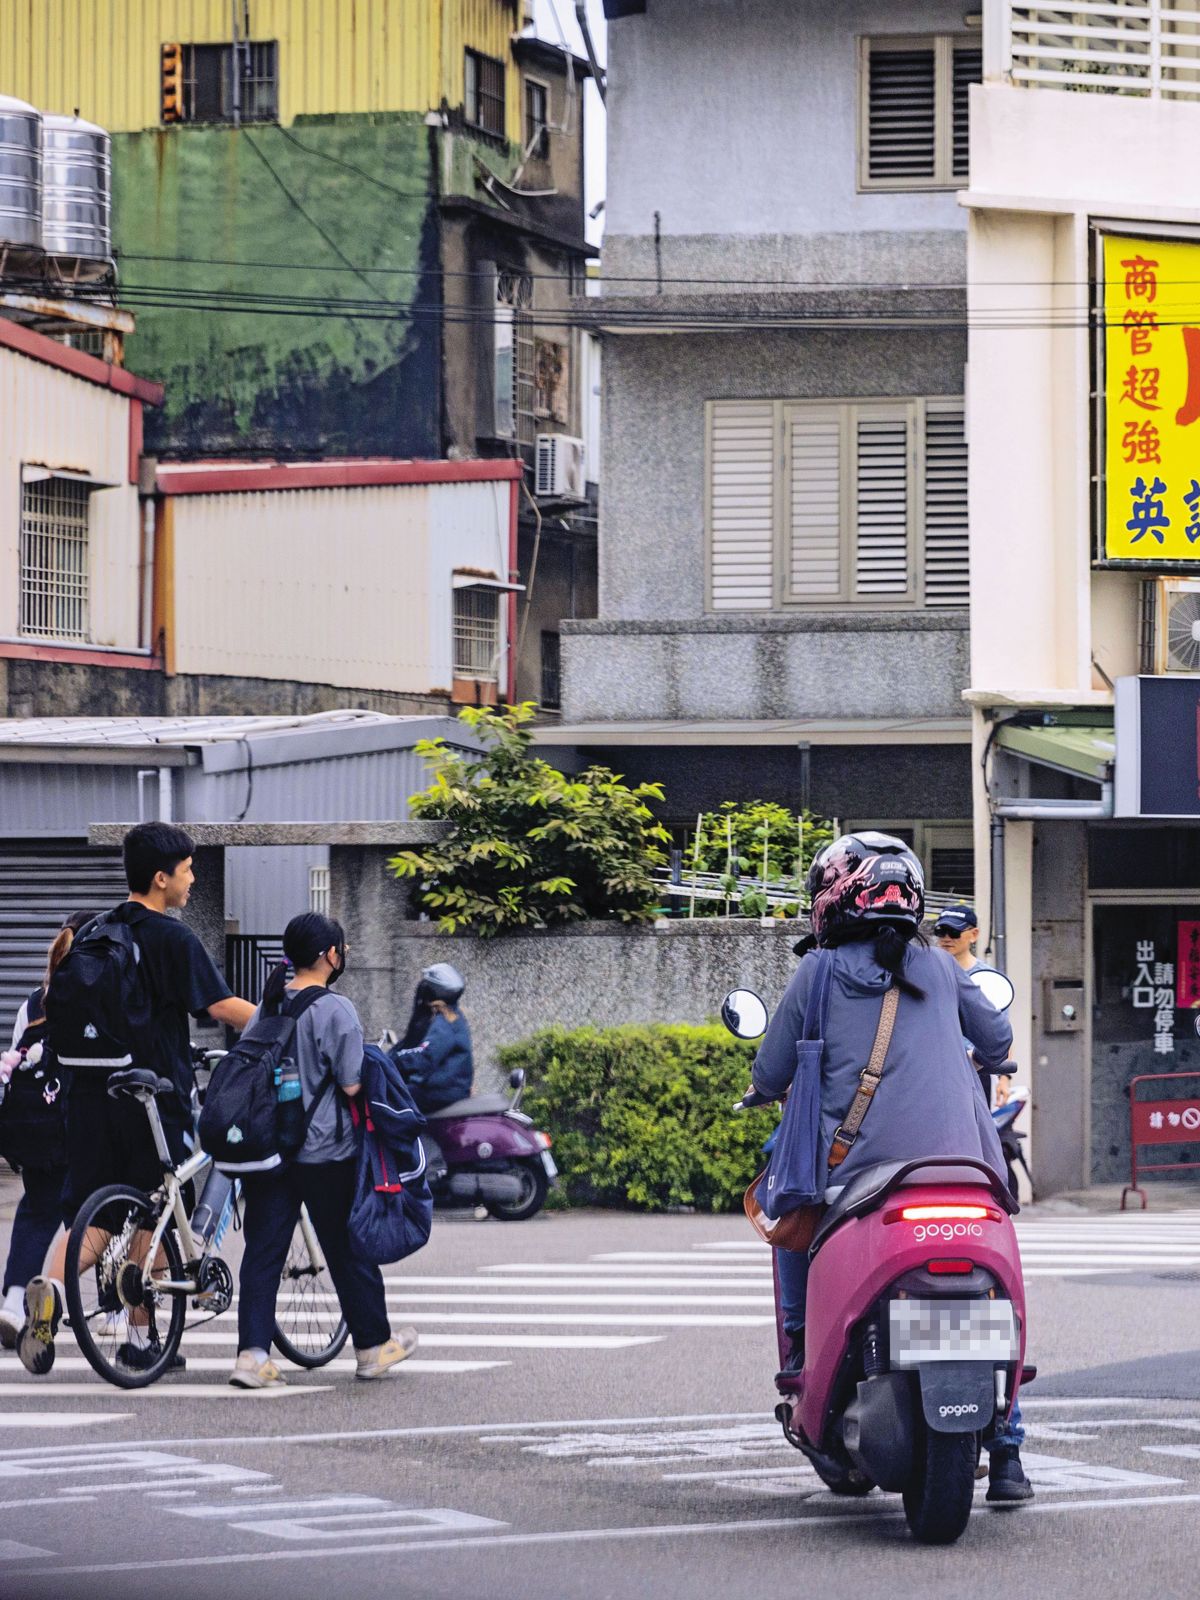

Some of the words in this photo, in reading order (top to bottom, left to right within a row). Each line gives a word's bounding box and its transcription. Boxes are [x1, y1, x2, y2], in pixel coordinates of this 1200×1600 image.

[1120, 254, 1163, 465] 商管超強
[1132, 940, 1154, 1008] 出入口
[1154, 962, 1175, 1054] 請勿停車
[913, 1223, 983, 1241] gogoro
[938, 1403, 978, 1417] gogoro
